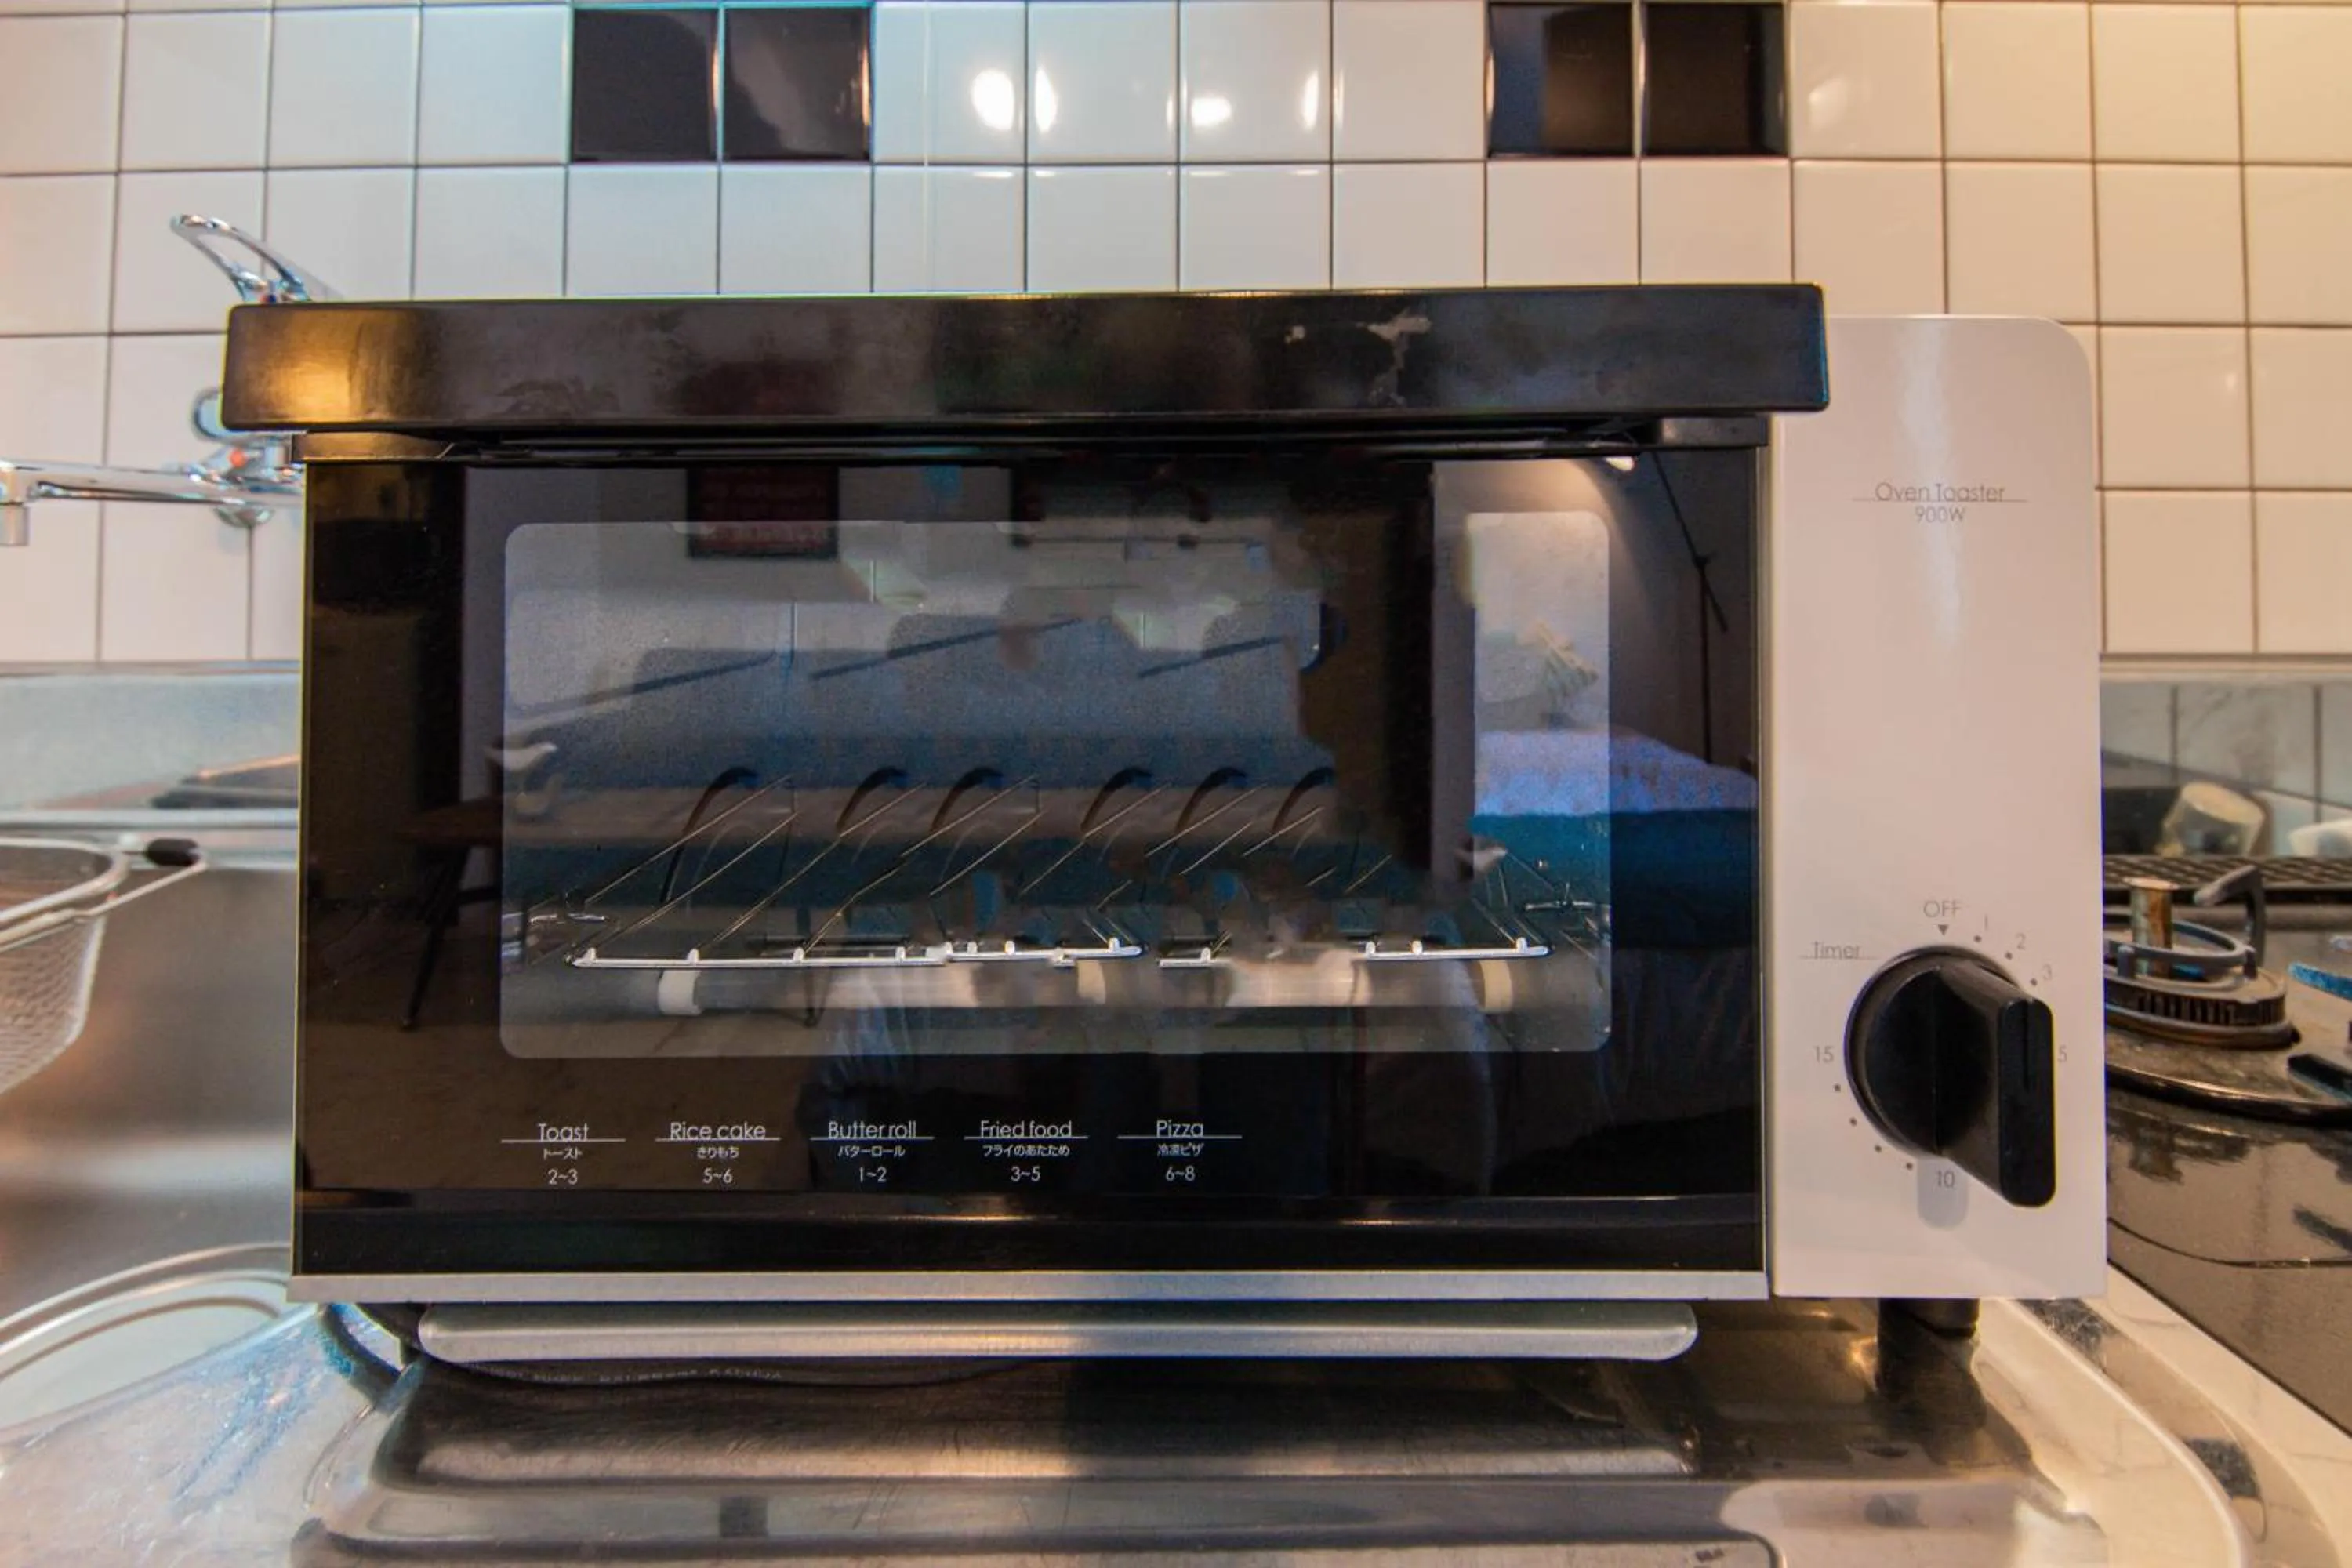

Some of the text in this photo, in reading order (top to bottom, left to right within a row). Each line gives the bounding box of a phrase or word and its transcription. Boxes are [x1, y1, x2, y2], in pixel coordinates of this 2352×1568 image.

[1875, 481, 2005, 502] Oven Toaster
[1915, 506, 1966, 523] 900W
[1923, 900, 1960, 919] OFF
[2016, 933, 2027, 949] 2
[1813, 941, 1861, 960] Timer
[2042, 965, 2053, 982] 3
[1813, 1045, 1835, 1063] 15
[2058, 1045, 2067, 1062] 5
[539, 1122, 589, 1141] Toast
[670, 1121, 766, 1140] Rice cake
[829, 1120, 916, 1139] Butter roll
[980, 1120, 1072, 1138] Fried food
[1156, 1120, 1204, 1138] Pizza
[543, 1147, 582, 1160] トースト
[696, 1146, 739, 1160] きりもち
[838, 1145, 906, 1158] バターロール
[982, 1145, 1070, 1157] フライのあたため
[1937, 1171, 1955, 1188] 10
